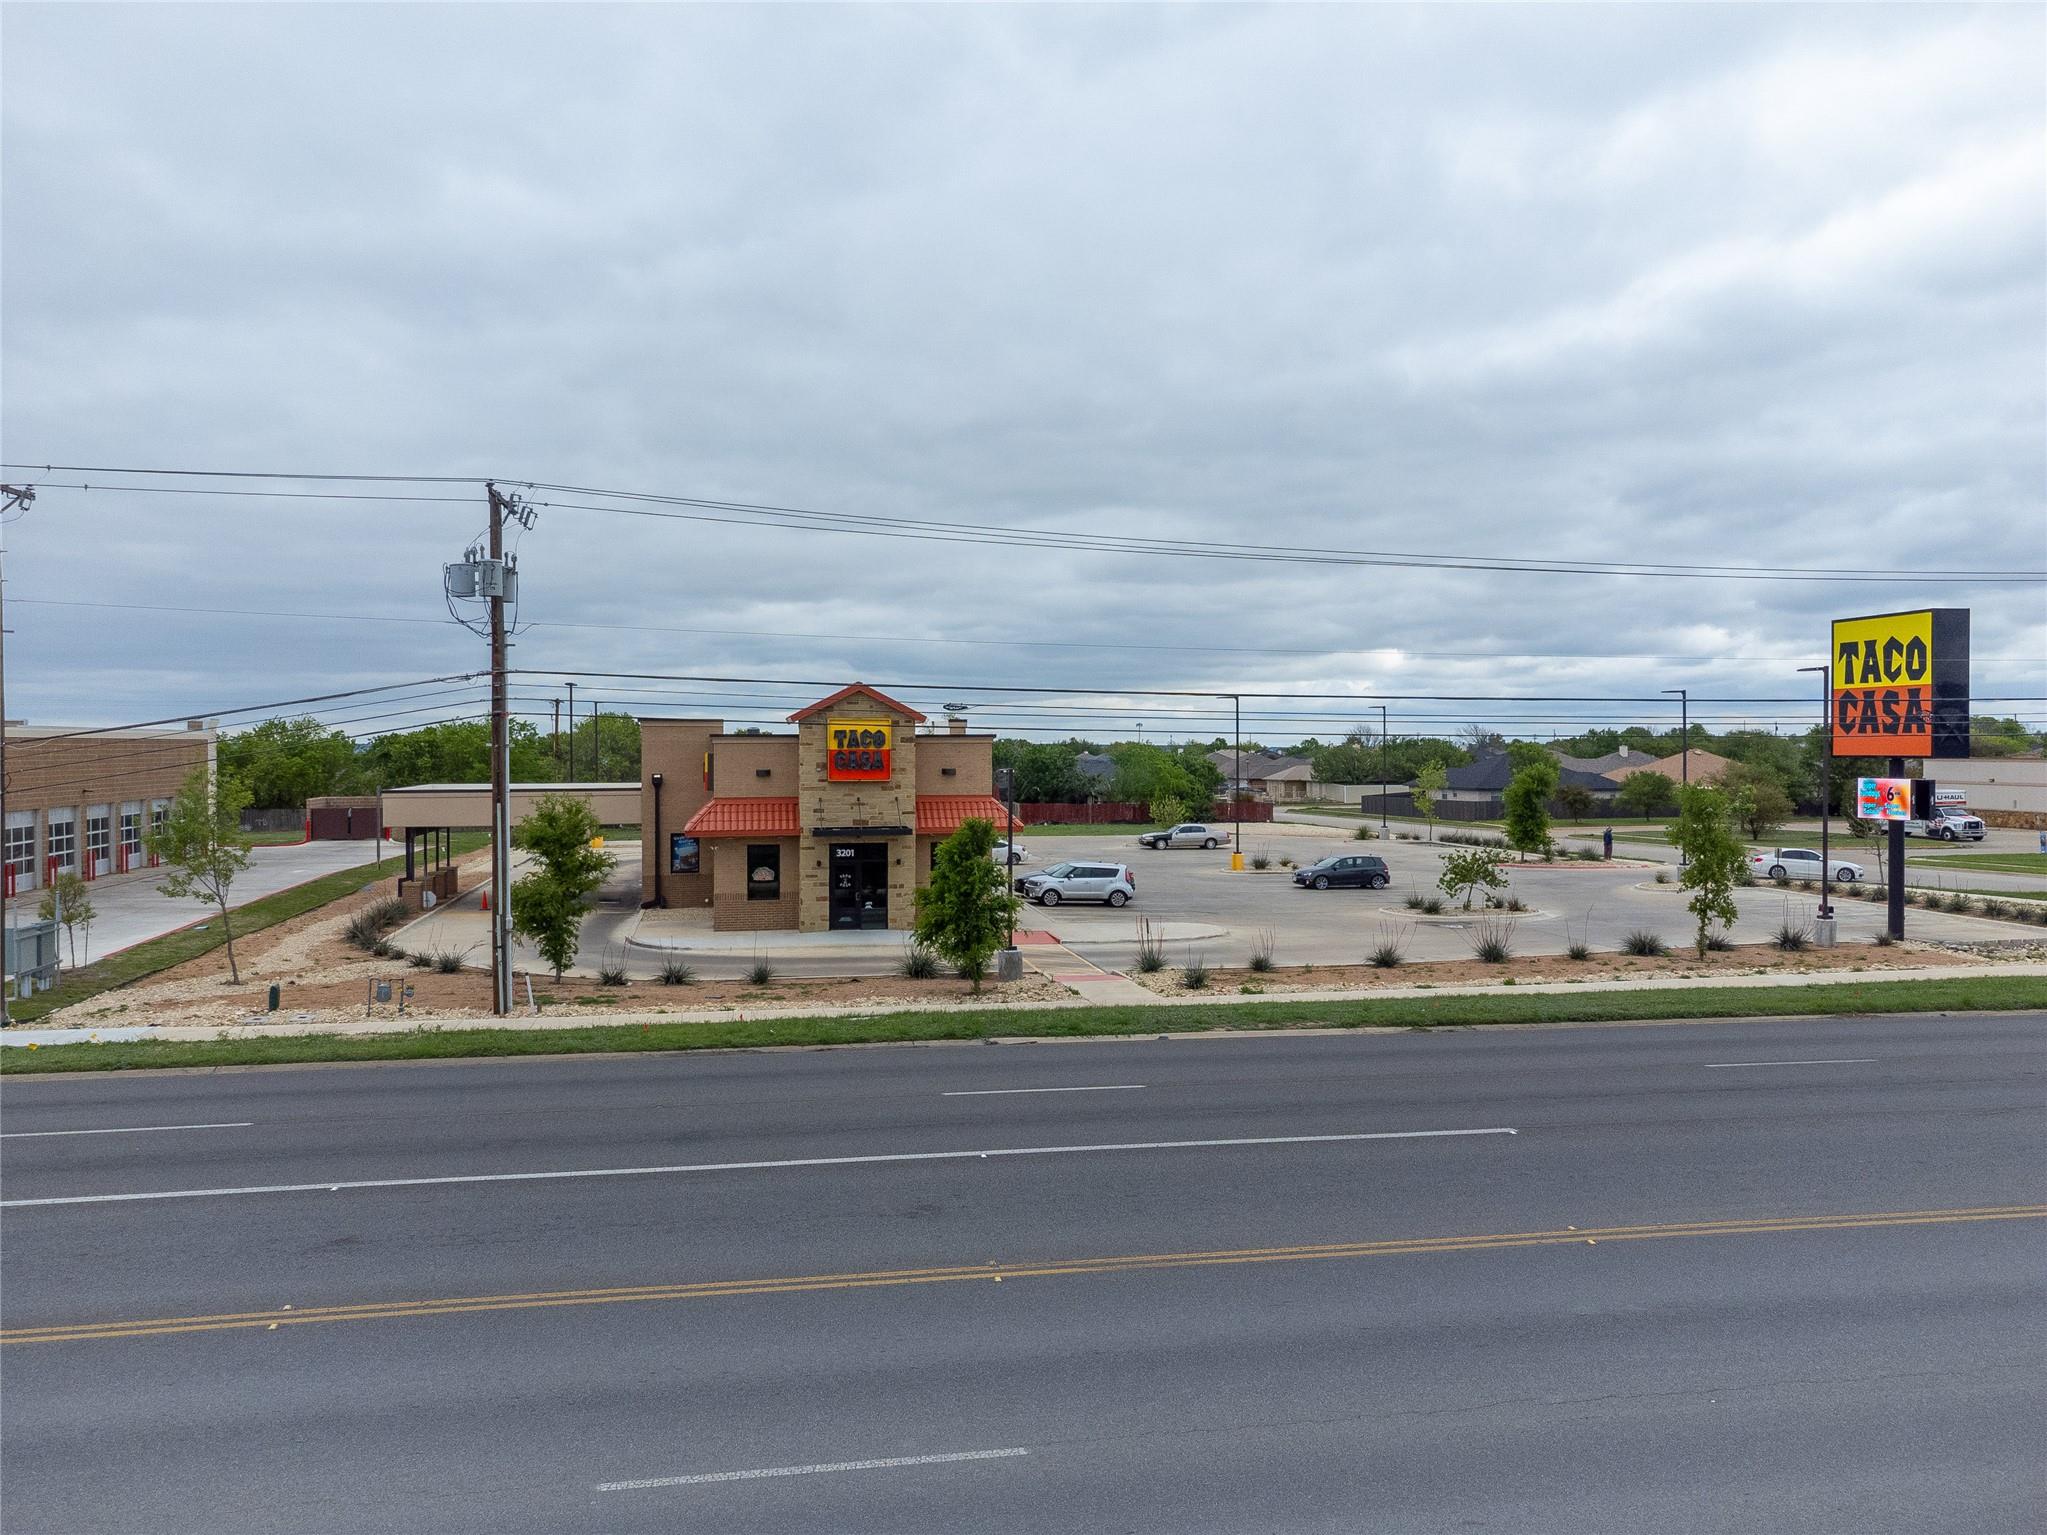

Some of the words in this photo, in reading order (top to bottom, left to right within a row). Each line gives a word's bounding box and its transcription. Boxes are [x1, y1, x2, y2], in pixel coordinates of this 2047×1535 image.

[1838, 635, 1927, 684] TACO
[1839, 687, 1927, 735] CASA
[833, 729, 886, 748] TACO
[834, 750, 885, 770] CASA
[836, 849, 855, 857] 3201
